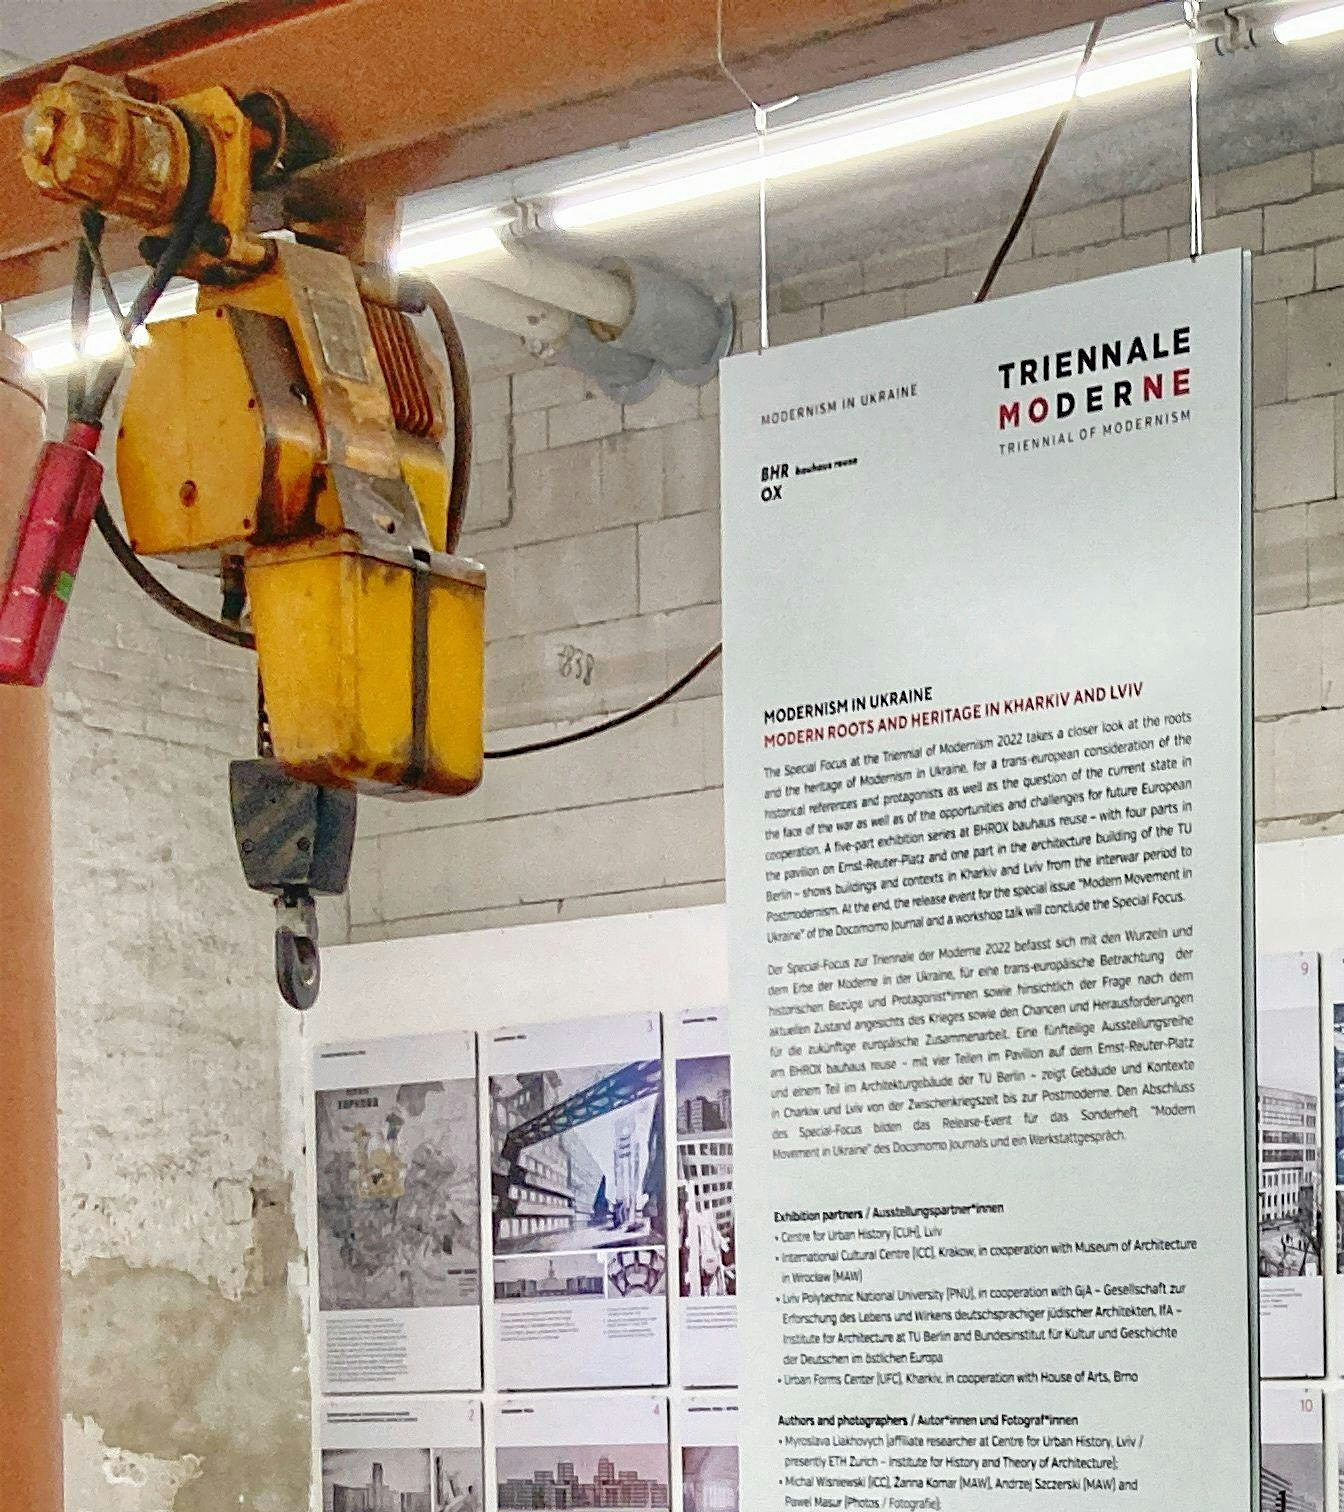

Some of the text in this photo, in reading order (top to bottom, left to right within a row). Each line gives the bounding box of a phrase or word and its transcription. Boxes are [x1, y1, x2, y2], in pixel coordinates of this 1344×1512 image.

[998, 326, 1192, 390] TRIENNALE
[761, 383, 917, 424] MODERNISM IN UKRAINE
[999, 367, 1190, 430] MODERNE
[999, 409, 1190, 455] TRIENNIAL OF MODERNISM
[760, 463, 789, 482] BHR
[760, 484, 782, 502] OX
[763, 686, 932, 725] MODERNISM IN UKRAINE
[764, 681, 1143, 748] MODERN ROOTS AND HERITAGE IN KHARKIV AND LVIV
[763, 711, 1192, 778] The Special Focus at the Triennial of Modernism 2022 takes a closer look at the roots
[764, 786, 782, 799] and
[785, 785, 800, 797] the
[803, 780, 842, 794] heritage
[846, 775, 856, 788] of
[859, 770, 912, 787] Modernism
[916, 767, 926, 778] in
[972, 759, 987, 771] for
[990, 759, 997, 770] a
[1083, 739, 1154, 757] consideration
[1158, 734, 1170, 748] of
[1173, 733, 1192, 746] the
[1300, 961, 1309, 976] 9
[773, 1210, 820, 1223] Exhibition
[822, 1209, 863, 1223] partners
[777, 1414, 815, 1426] Authors
[816, 1414, 835, 1426] and
[837, 1414, 908, 1428] photographers
[979, 1414, 999, 1426] und
[1300, 1398, 1313, 1412] 10
